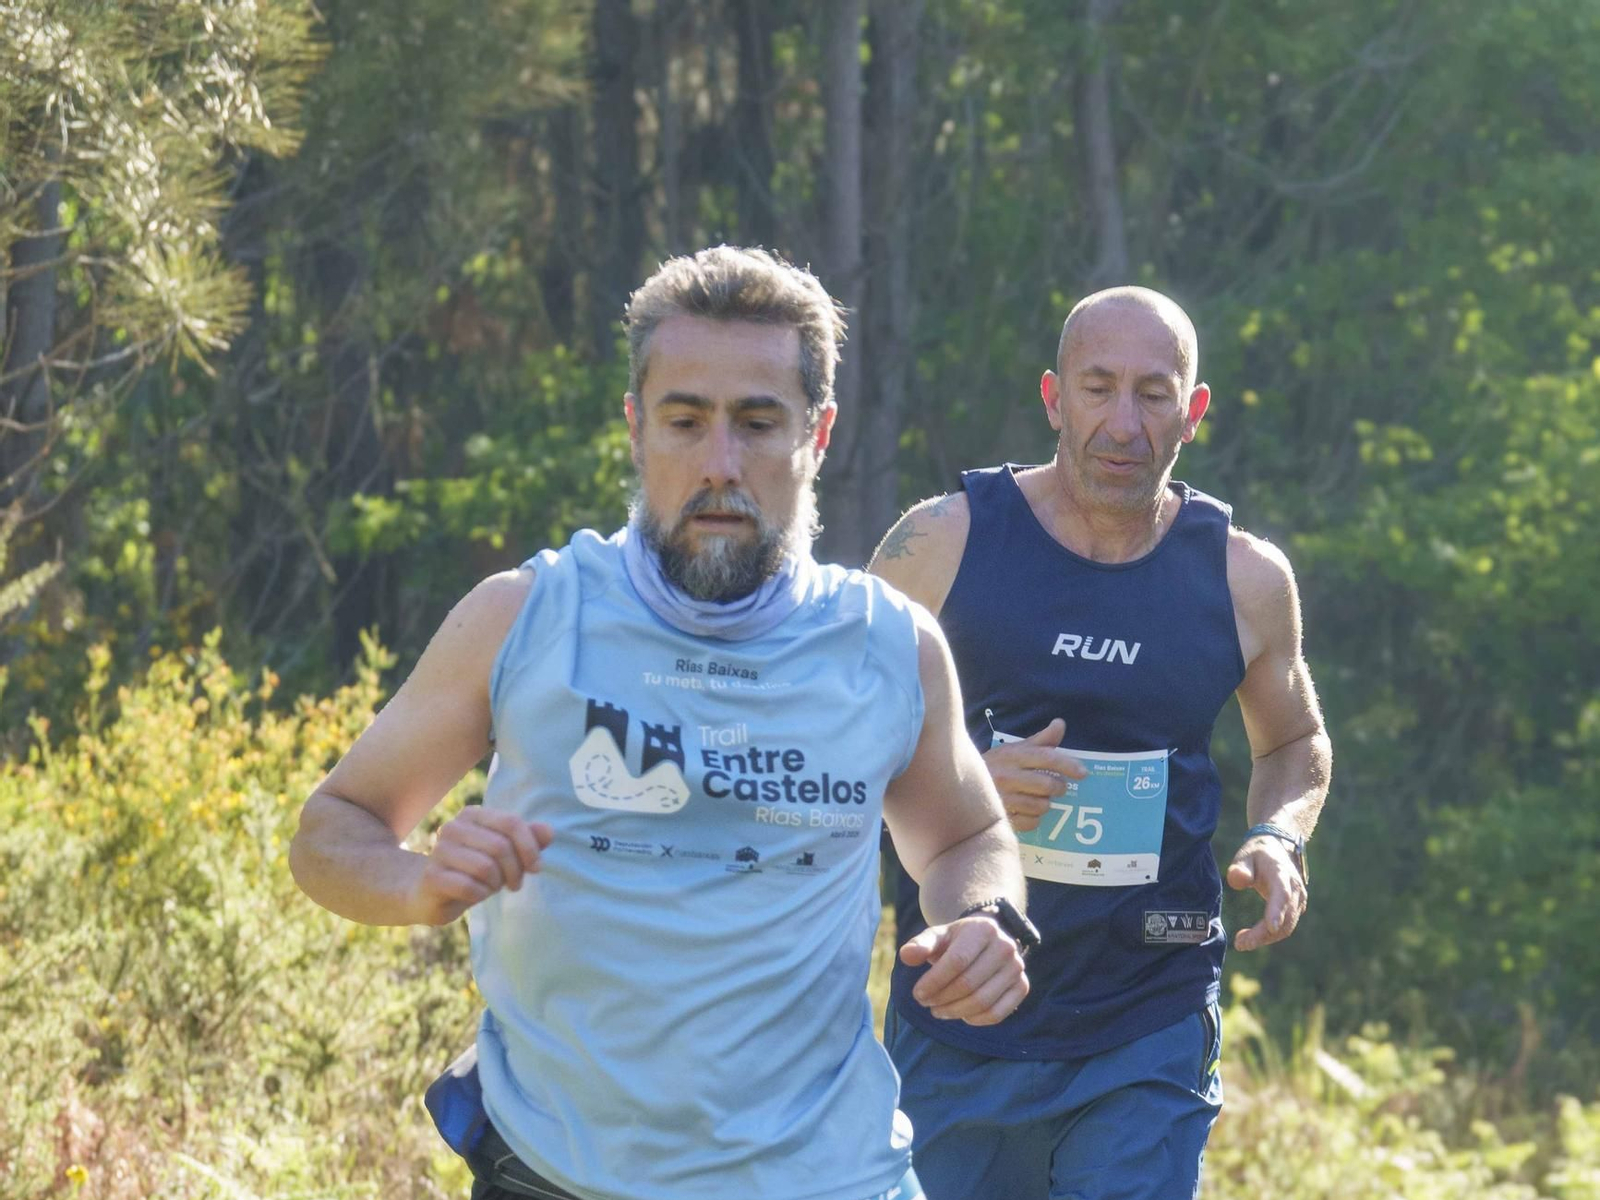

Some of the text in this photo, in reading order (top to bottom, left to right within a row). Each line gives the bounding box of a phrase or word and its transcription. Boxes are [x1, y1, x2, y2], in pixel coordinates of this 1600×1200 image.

[1052, 633, 1141, 665] RUN
[643, 671, 662, 685] Tu
[675, 658, 758, 681] Rías Baixas
[698, 723, 748, 747] Trail
[701, 746, 805, 774] Entre
[702, 770, 867, 805] Castelos
[1132, 776, 1150, 791] 26
[755, 806, 865, 829] Rías Baixas
[1048, 801, 1103, 845] 75
